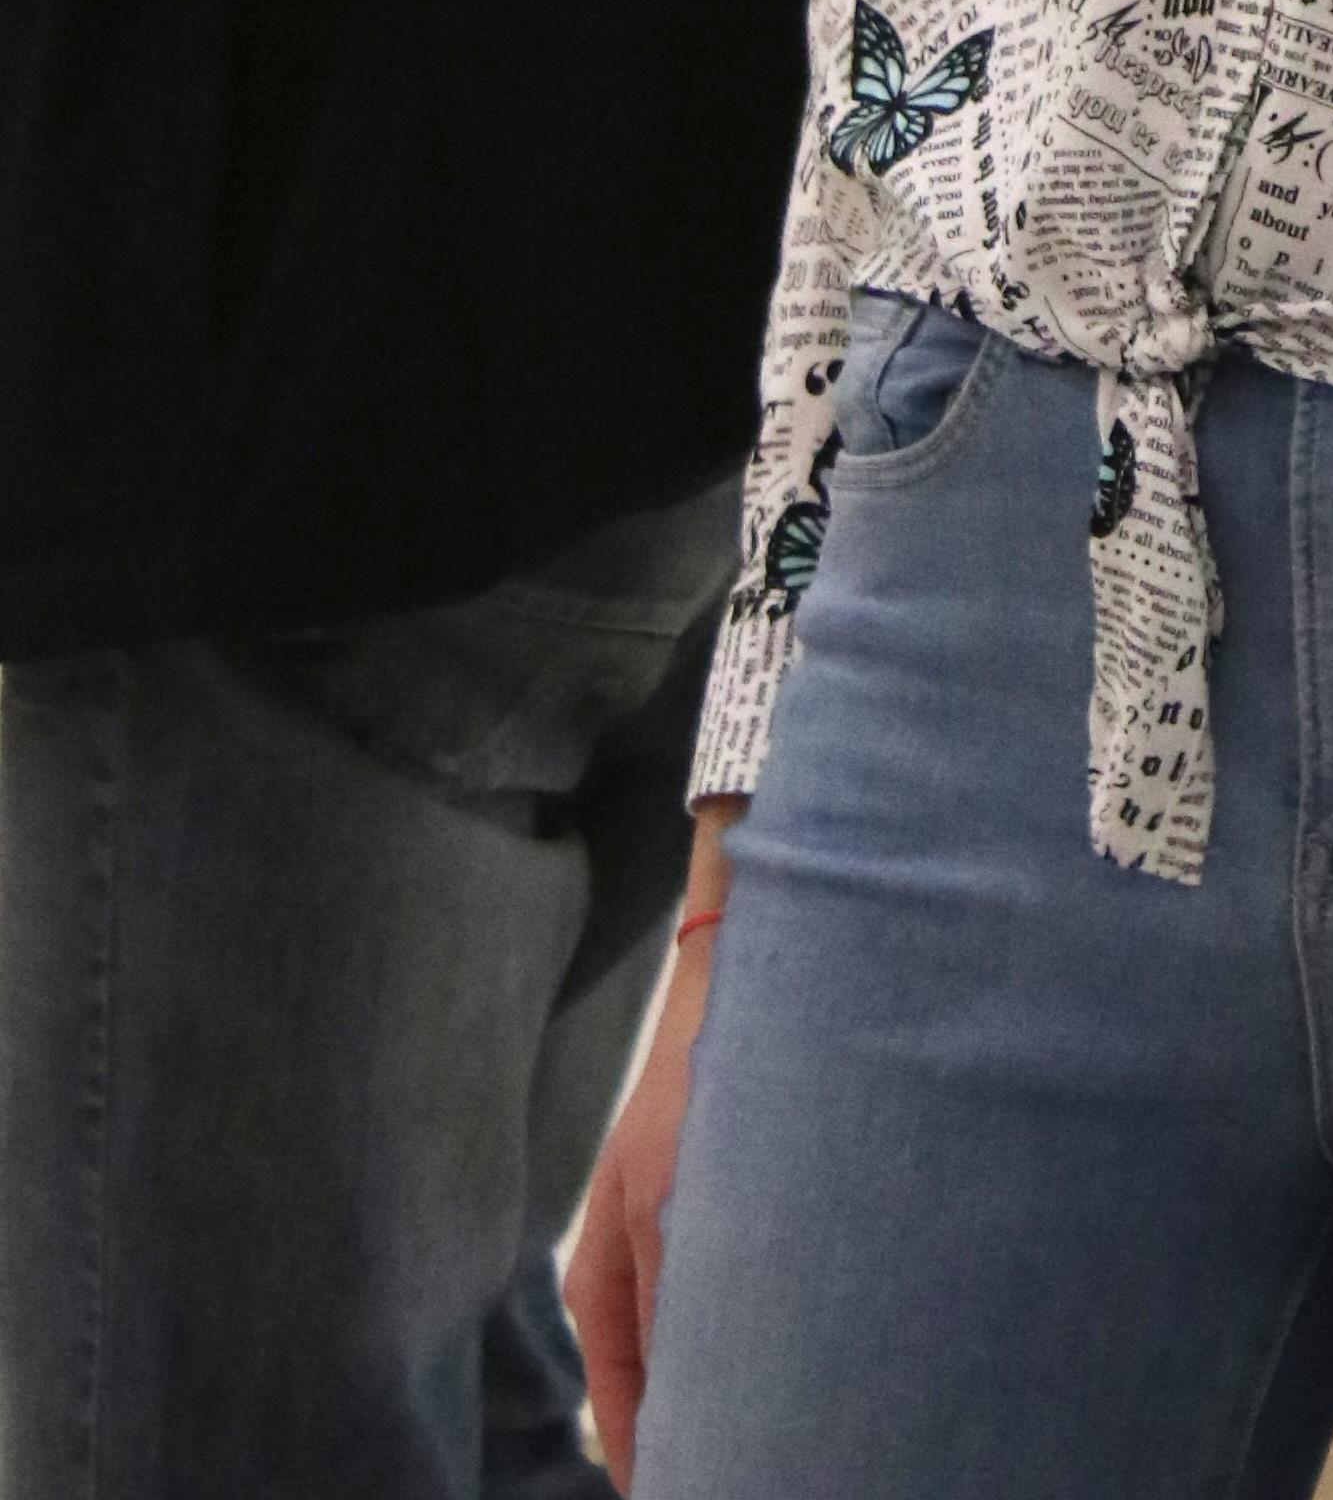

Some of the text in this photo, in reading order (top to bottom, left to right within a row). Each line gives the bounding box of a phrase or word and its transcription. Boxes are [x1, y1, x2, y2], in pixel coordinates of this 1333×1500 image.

[920, 154, 960, 169] every
[929, 172, 962, 185] your
[1258, 178, 1300, 204] and
[935, 192, 962, 205] you
[937, 206, 964, 219] and
[1250, 206, 1310, 243] about
